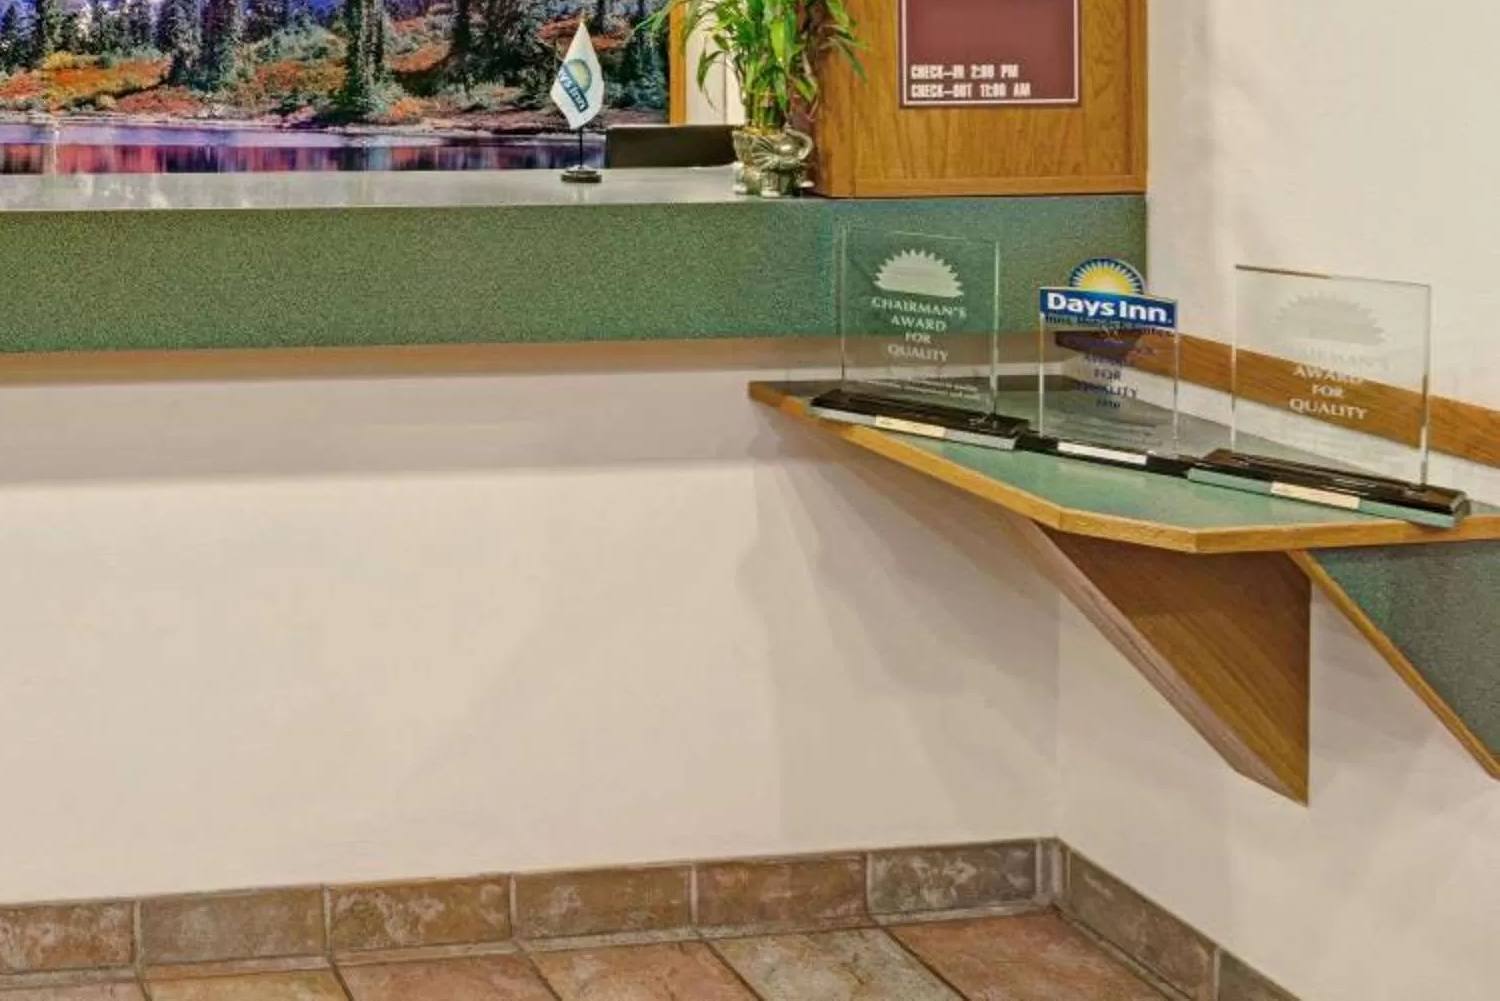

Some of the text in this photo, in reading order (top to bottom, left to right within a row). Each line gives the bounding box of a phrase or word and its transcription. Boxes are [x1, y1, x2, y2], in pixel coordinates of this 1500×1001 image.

[910, 63, 966, 80] CHECK-IN
[1000, 63, 1020, 79] PM
[910, 82, 973, 99] CHECK-OUT
[1013, 82, 1032, 98] AM
[871, 296, 968, 320] CHAIRMAN'S
[1047, 291, 1116, 317] Days
[1119, 300, 1169, 323] Inn
[890, 314, 948, 332] AWARD
[905, 331, 932, 344] FOR
[887, 342, 949, 362] QUALITY
[1311, 382, 1345, 399] FOR
[1288, 398, 1370, 420] QUALITY
